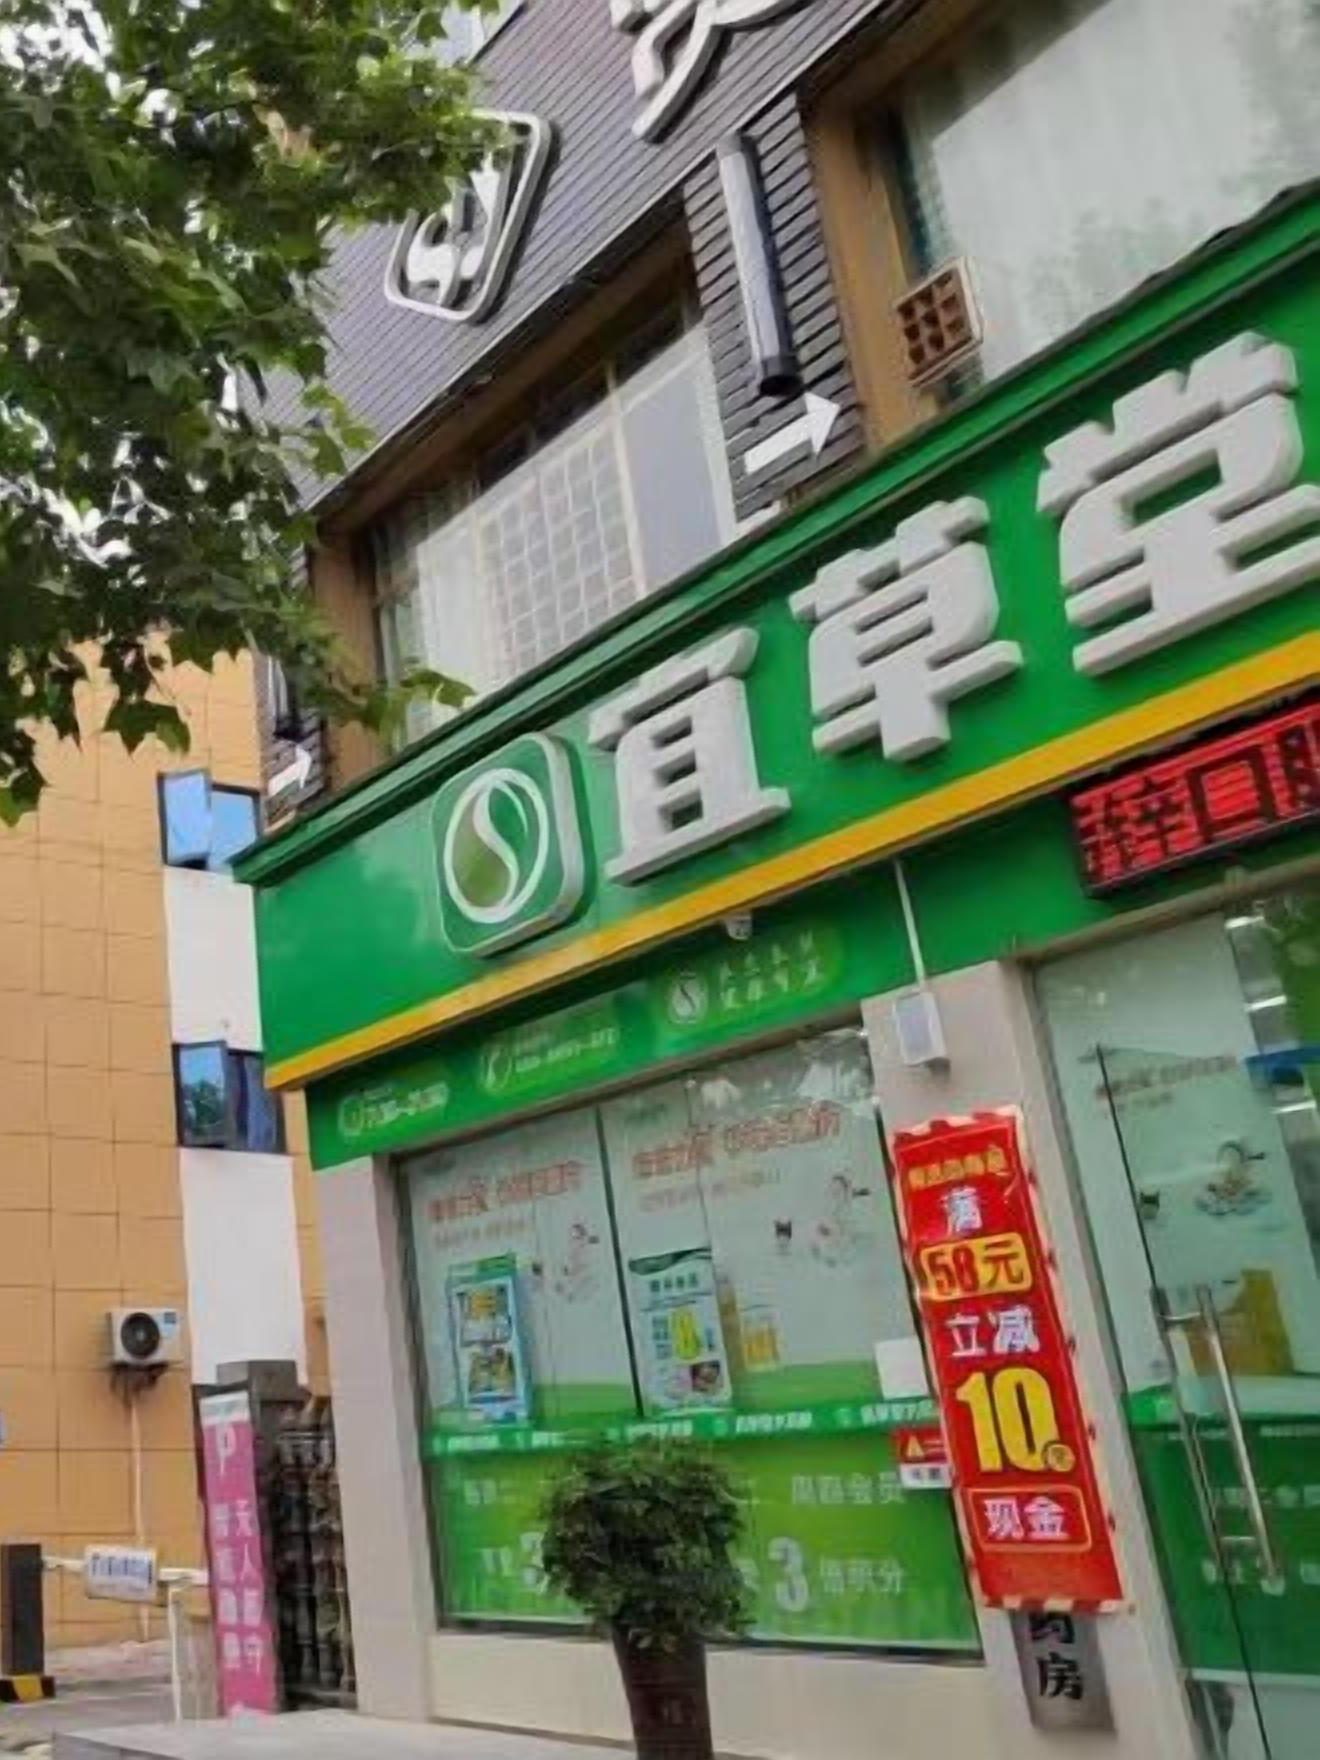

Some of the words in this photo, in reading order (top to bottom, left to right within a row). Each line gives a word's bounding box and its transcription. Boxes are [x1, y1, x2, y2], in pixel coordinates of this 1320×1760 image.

[588, 330, 1320, 886] 宜草堂
[942, 1185, 984, 1236] 满
[928, 1239, 1026, 1298] 58元
[945, 1304, 1042, 1358] 立减
[982, 1496, 1070, 1541] 现金
